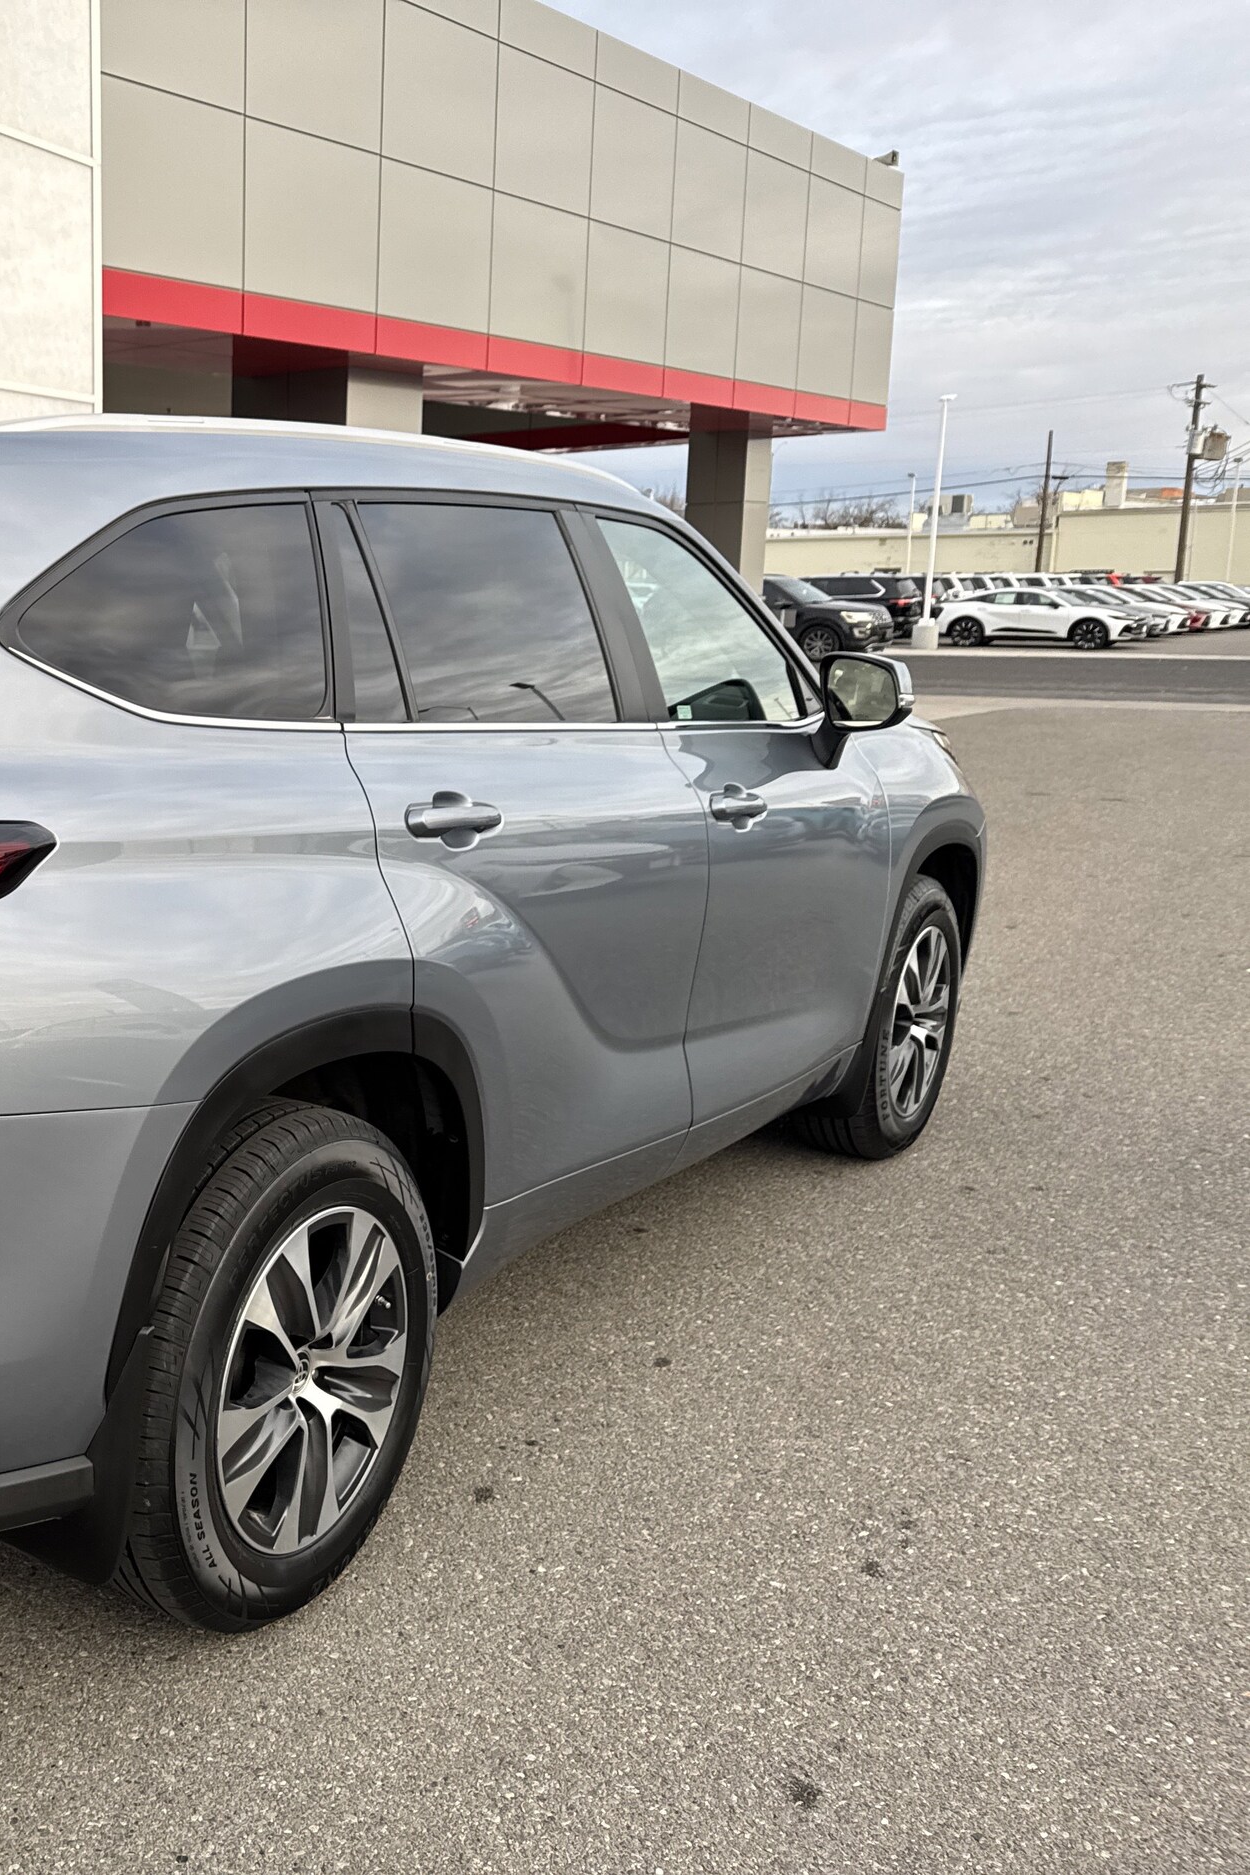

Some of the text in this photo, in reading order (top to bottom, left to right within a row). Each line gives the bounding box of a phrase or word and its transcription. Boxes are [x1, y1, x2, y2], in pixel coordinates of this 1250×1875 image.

[878, 1028, 890, 1121] FORTUNE
[189, 1472, 206, 1542] SEASON
[201, 1543, 218, 1569] ALL
